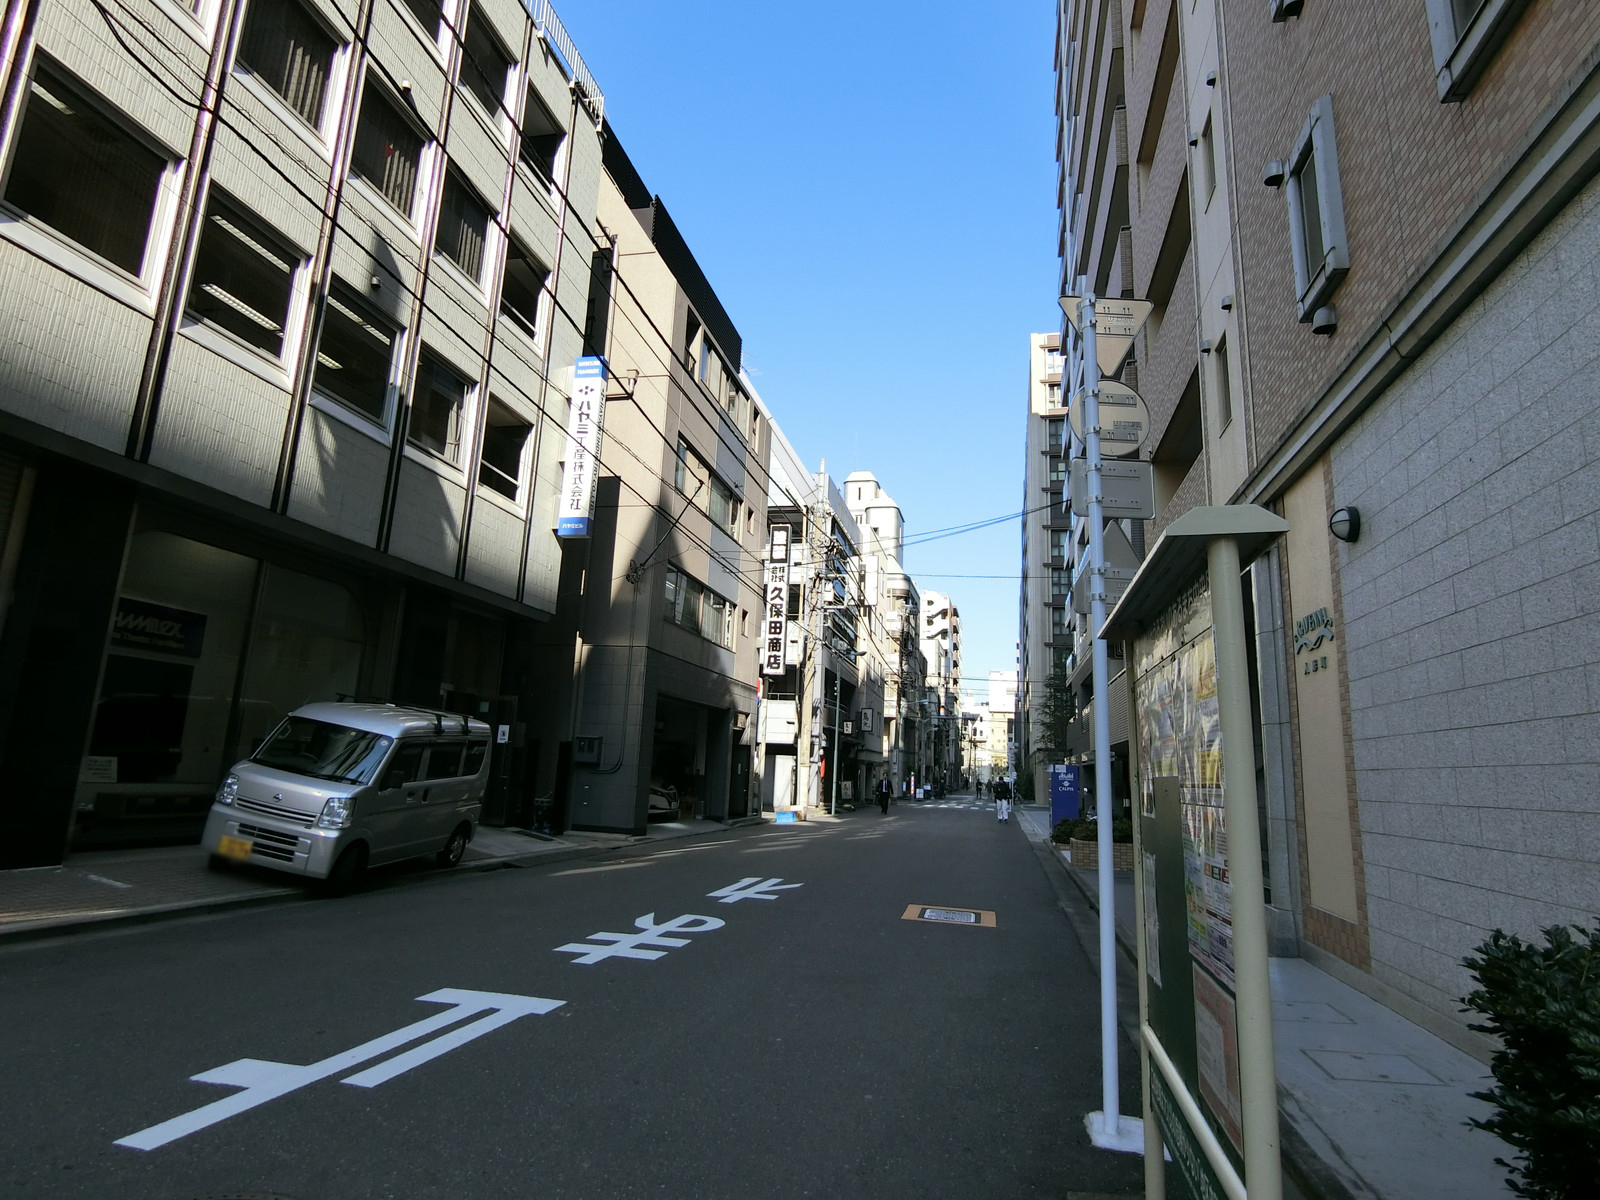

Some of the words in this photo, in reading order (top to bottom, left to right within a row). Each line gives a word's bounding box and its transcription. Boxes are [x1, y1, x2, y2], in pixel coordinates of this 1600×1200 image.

[767, 586, 785, 670] 久保田商店
